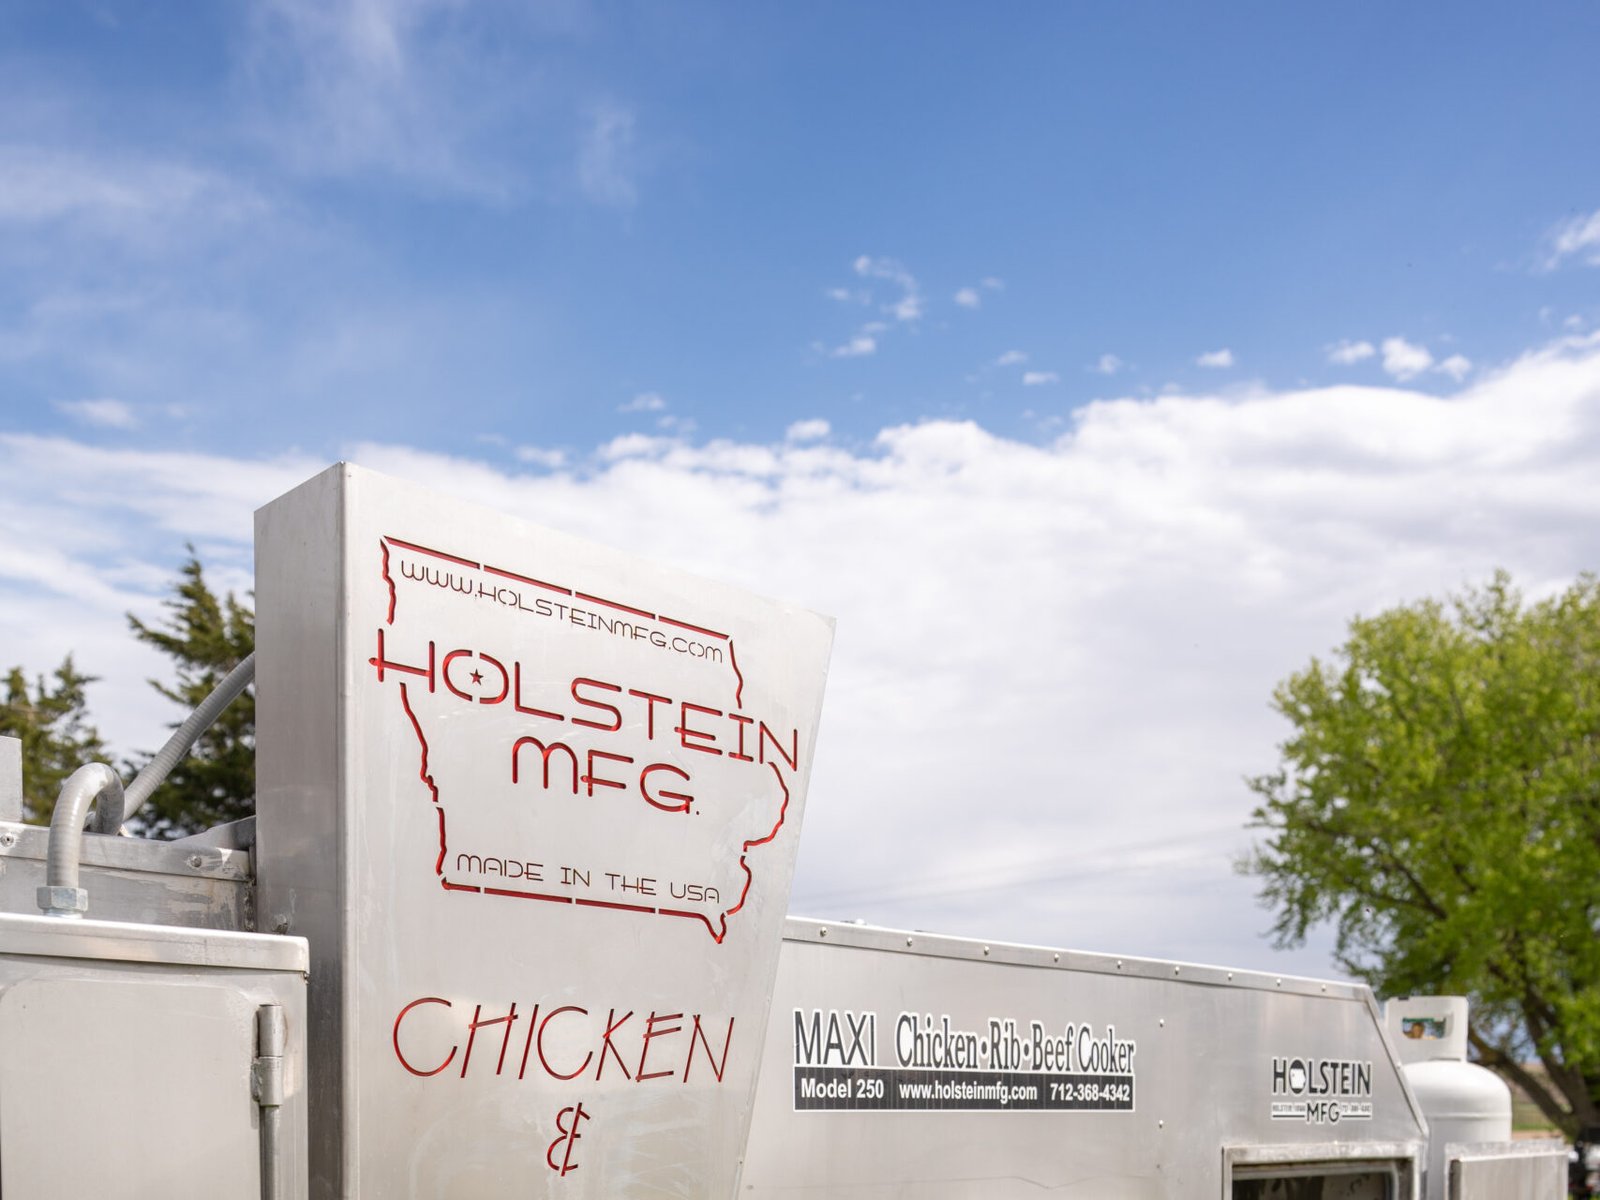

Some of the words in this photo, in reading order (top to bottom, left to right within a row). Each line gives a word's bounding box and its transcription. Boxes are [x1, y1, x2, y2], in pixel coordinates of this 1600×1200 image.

[400, 558, 724, 664] WWW.HOLSTEINMFG.COM
[369, 628, 798, 772] HOLSTEIN
[512, 735, 700, 816] MFG.
[456, 852, 545, 883] MADE
[559, 866, 591, 888] IN
[604, 872, 658, 897] THE
[669, 882, 721, 905] USA
[392, 996, 735, 1084] CHICKEN
[794, 1009, 876, 1067] MAXI
[1077, 1024, 1136, 1075] Cooker
[800, 1077, 852, 1099] Model
[856, 1078, 885, 1099] 250
[899, 1078, 1039, 1105] www.holsteinmfg.com
[1049, 1082, 1131, 1102] 712-368-4342
[1273, 1058, 1371, 1095] HOLSTEIN
[1306, 1101, 1340, 1123] MFG
